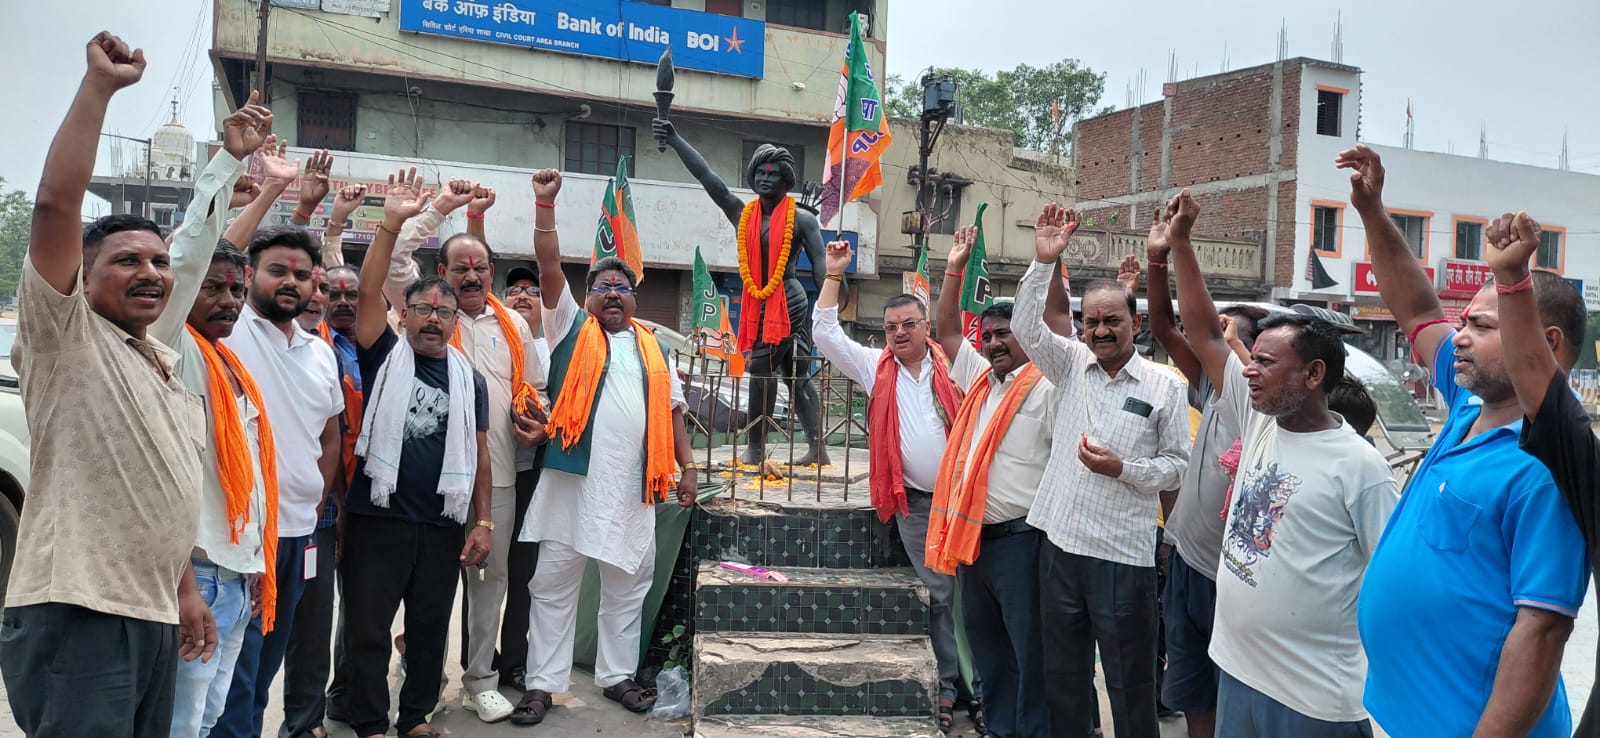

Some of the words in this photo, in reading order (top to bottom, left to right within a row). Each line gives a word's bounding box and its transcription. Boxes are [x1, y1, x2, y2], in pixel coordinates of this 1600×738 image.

[492, 3, 536, 25] इंडिया
[495, 31, 513, 40] CIVIL
[513, 33, 535, 43] COURT
[535, 36, 552, 45] AREA
[553, 39, 580, 49] BRANCH
[557, 11, 602, 36] Bank
[606, 21, 624, 38] of
[628, 22, 670, 45] India
[686, 31, 719, 52] BOI
